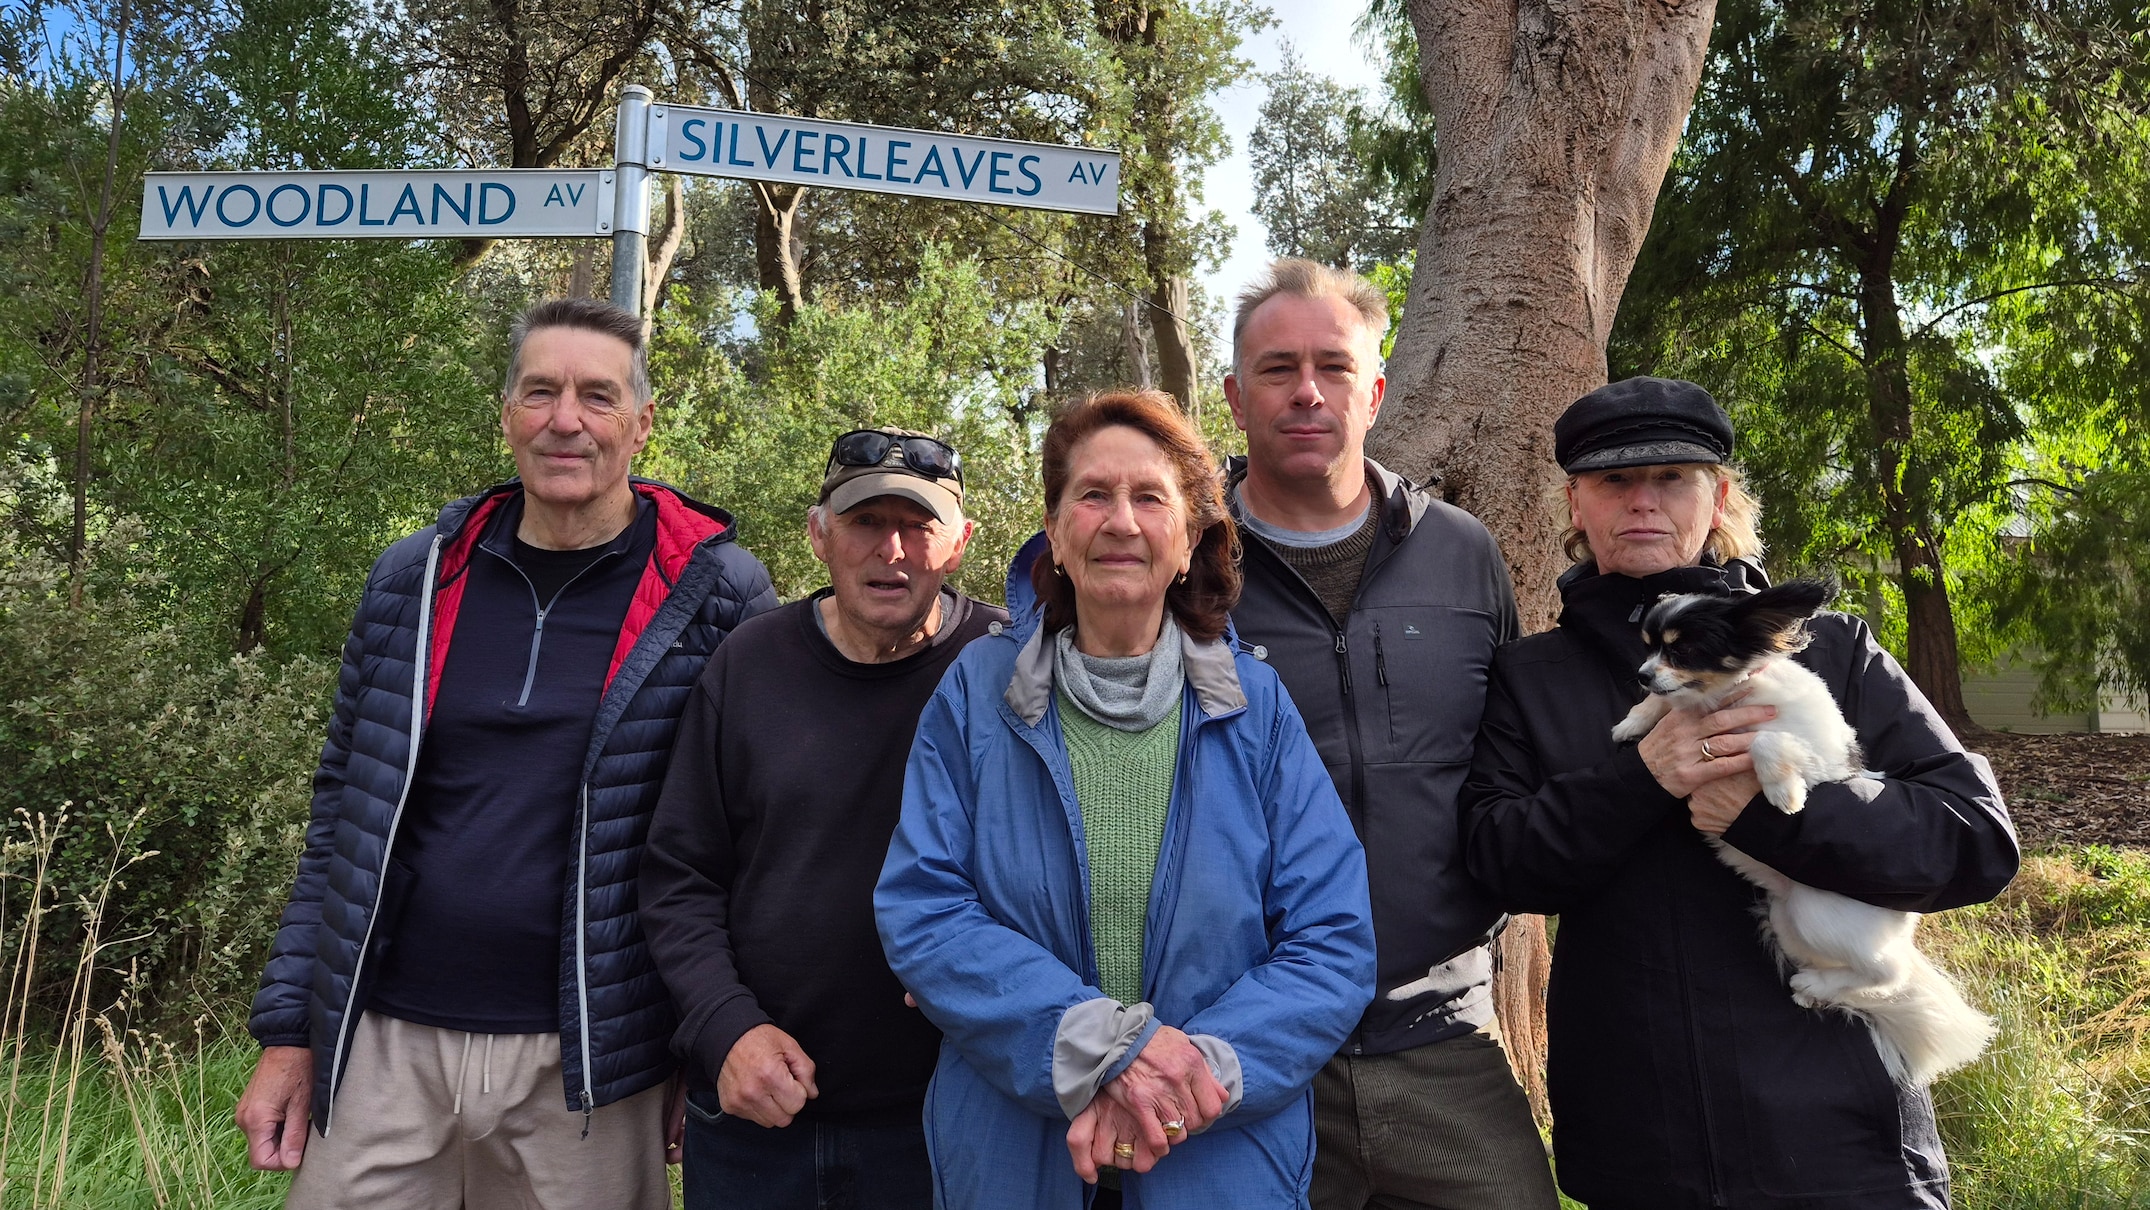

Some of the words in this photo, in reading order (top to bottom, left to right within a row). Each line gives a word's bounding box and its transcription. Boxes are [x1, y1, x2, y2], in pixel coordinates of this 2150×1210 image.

[678, 118, 1042, 197] SILVERLEAVES
[1067, 160, 1108, 186] AV
[157, 182, 517, 229] WOODLAND
[543, 183, 586, 208] AV
[670, 639, 683, 649] du
